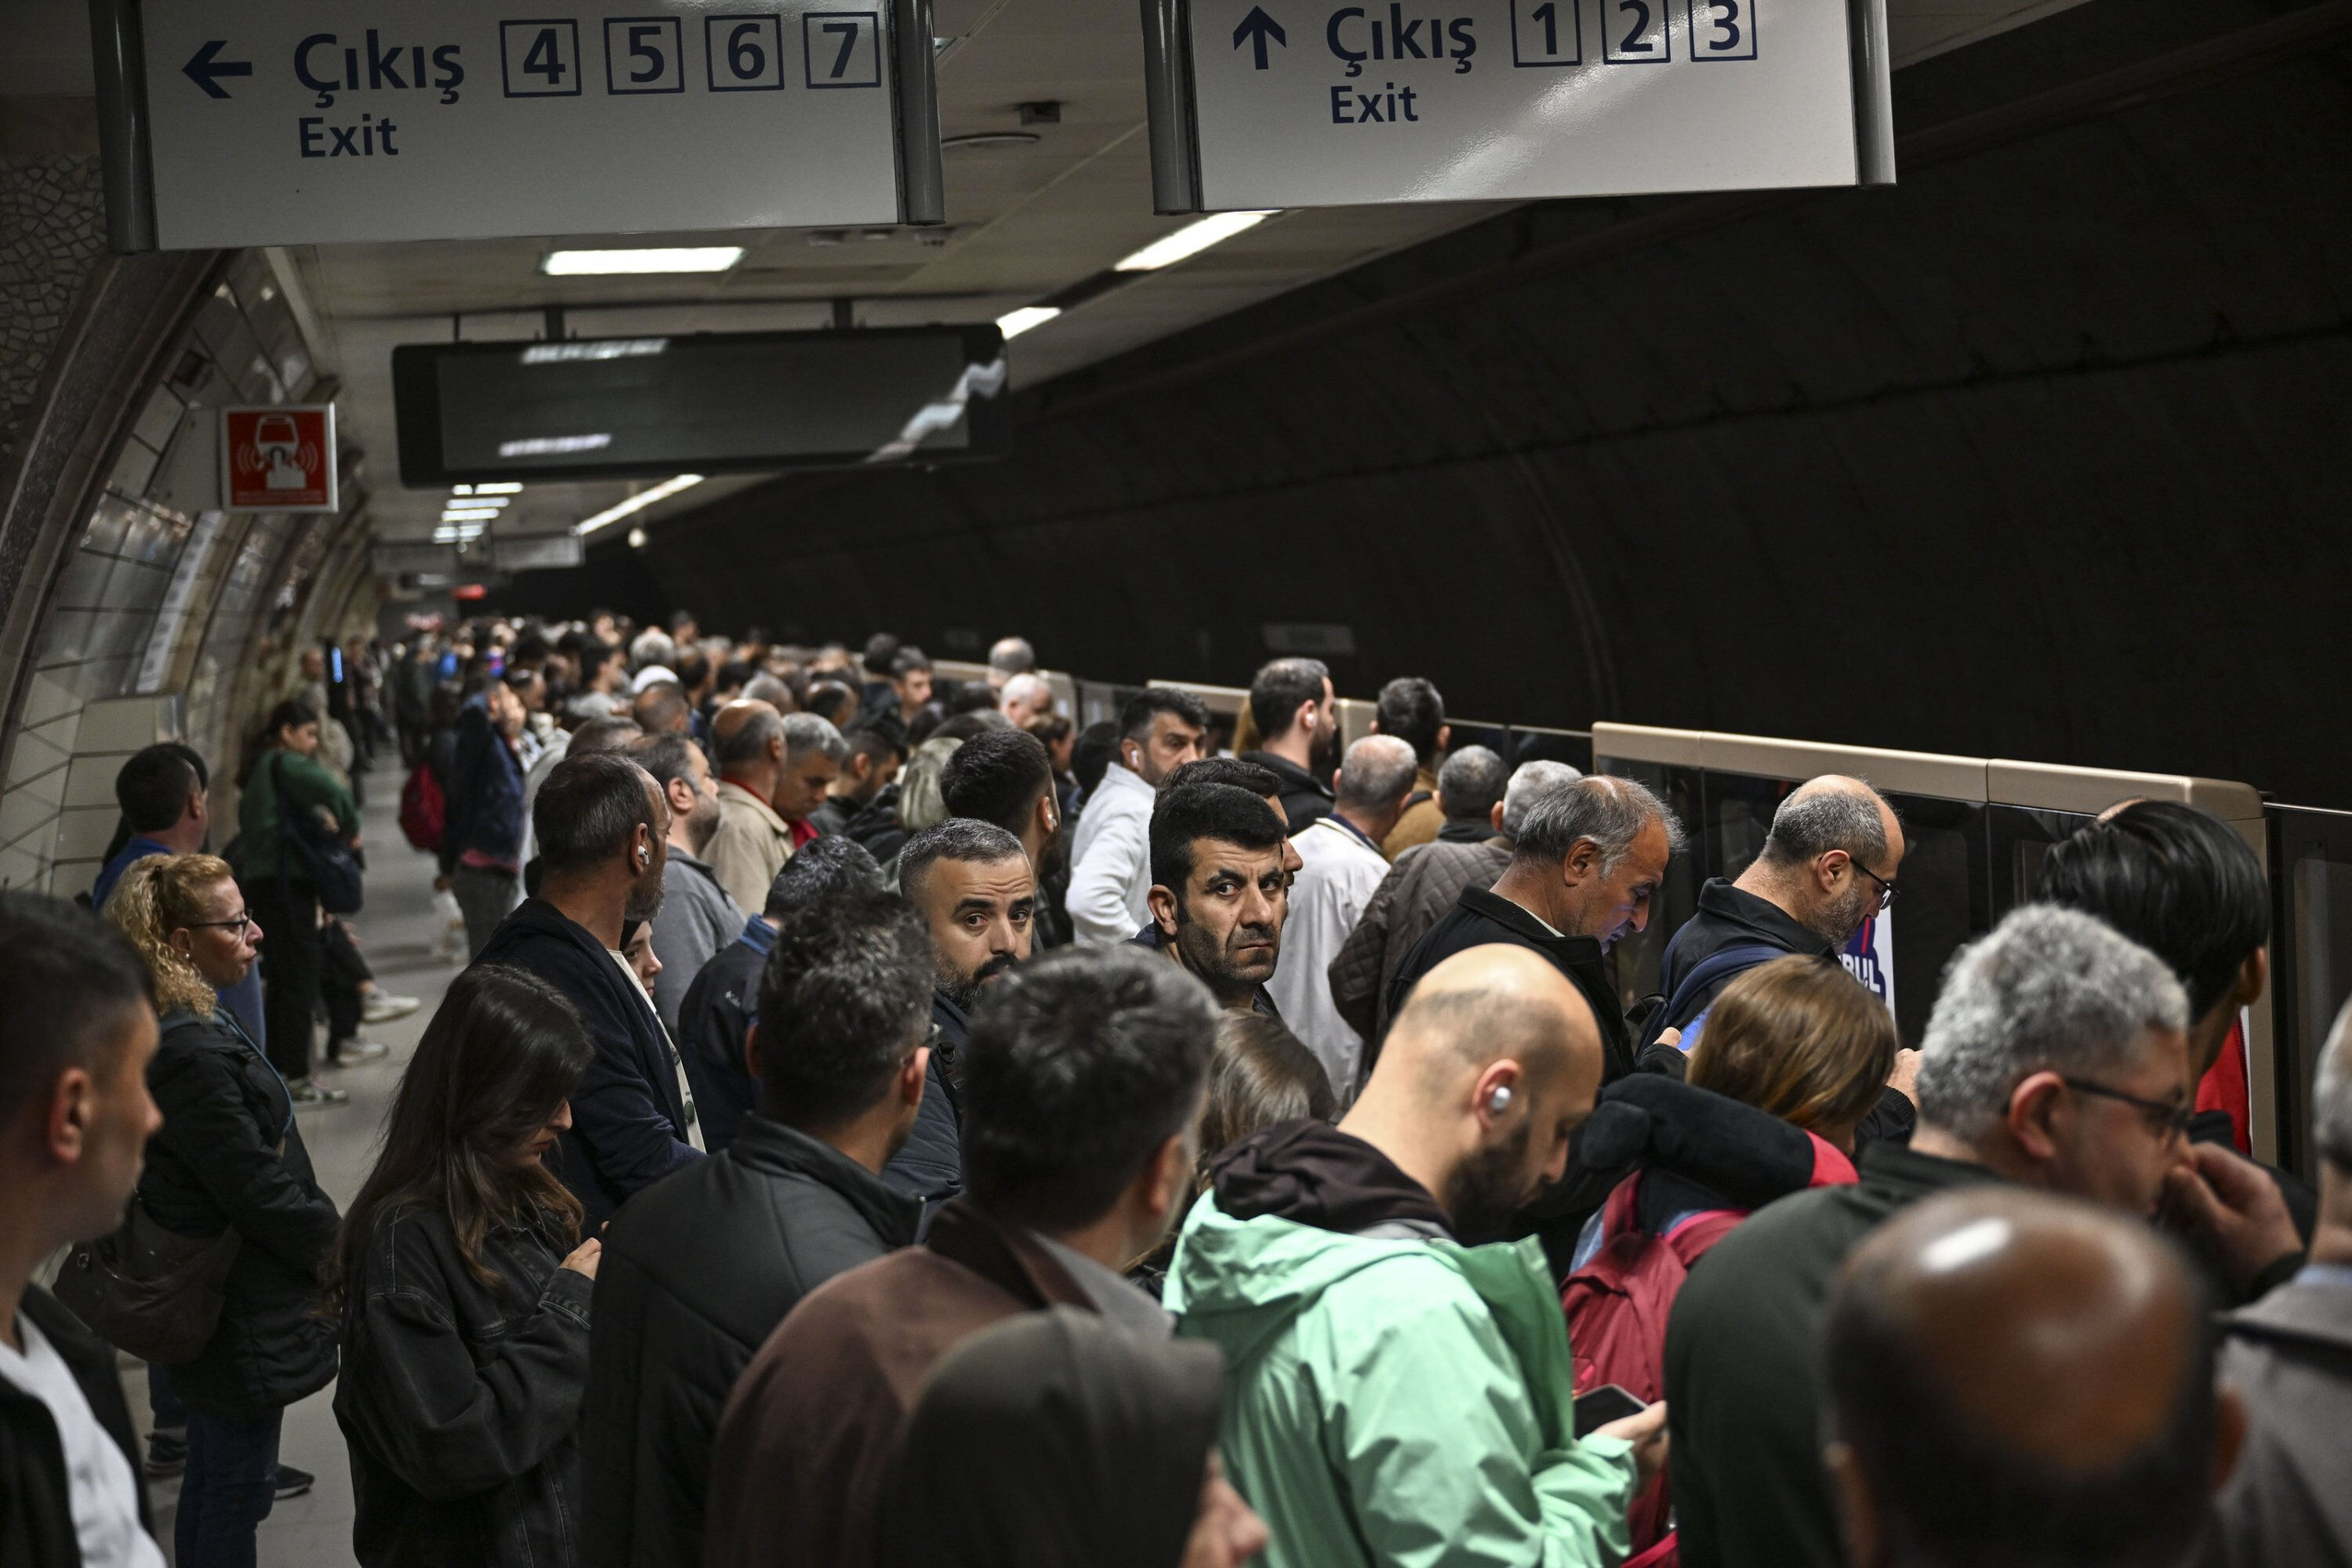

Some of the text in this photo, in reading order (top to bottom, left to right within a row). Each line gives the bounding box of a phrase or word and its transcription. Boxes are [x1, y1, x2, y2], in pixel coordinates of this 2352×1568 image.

[293, 22, 858, 109] Çıkış 4 5 6 7
[1326, 0, 1740, 78] Çıkış 1 2 3
[1330, 82, 1419, 124] Exit
[299, 113, 399, 158] Exit
